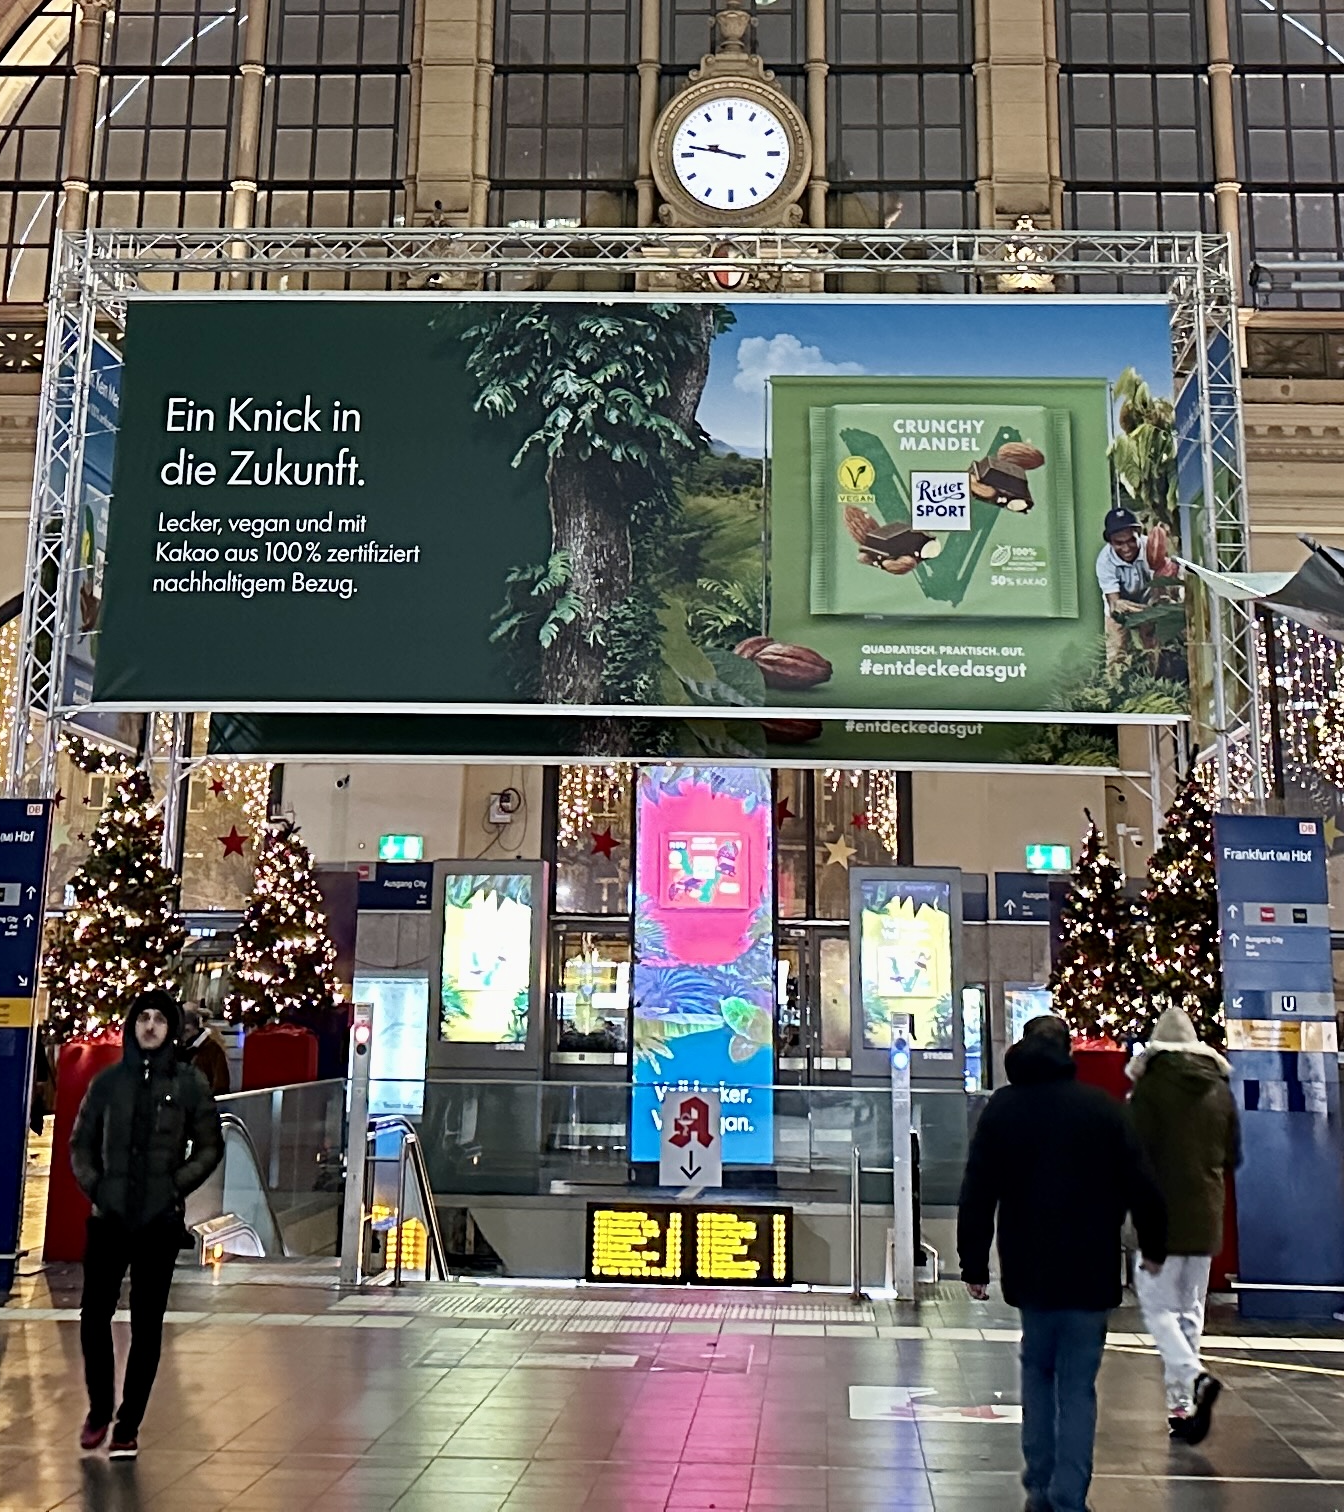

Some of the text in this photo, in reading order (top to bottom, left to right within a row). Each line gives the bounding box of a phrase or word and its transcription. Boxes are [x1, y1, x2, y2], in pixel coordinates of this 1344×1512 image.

[166, 394, 361, 432] Ein Knick in
[892, 419, 985, 434] CRUNCHY
[899, 437, 981, 451] MANDEL
[160, 447, 365, 486] die Zukunft.
[915, 480, 966, 503] Ritter
[915, 504, 966, 517] SPORT
[158, 510, 367, 539] Lecker, vegan und mit
[155, 539, 220, 562] Kakao
[224, 547, 259, 562] aus
[326, 540, 421, 563] zertifiziert
[152, 569, 359, 600] nachhaltigem Bezug.
[991, 575, 1048, 587] 50% KAKAO
[859, 658, 1027, 682] #entdeckedasgut
[845, 720, 984, 738] #entdeckedasgut
[14, 830, 35, 843] Hbf
[1301, 823, 1315, 834] DB
[1223, 847, 1276, 861] Frankfurt
[1291, 849, 1312, 862] Hbf
[1283, 996, 1295, 1011] U
